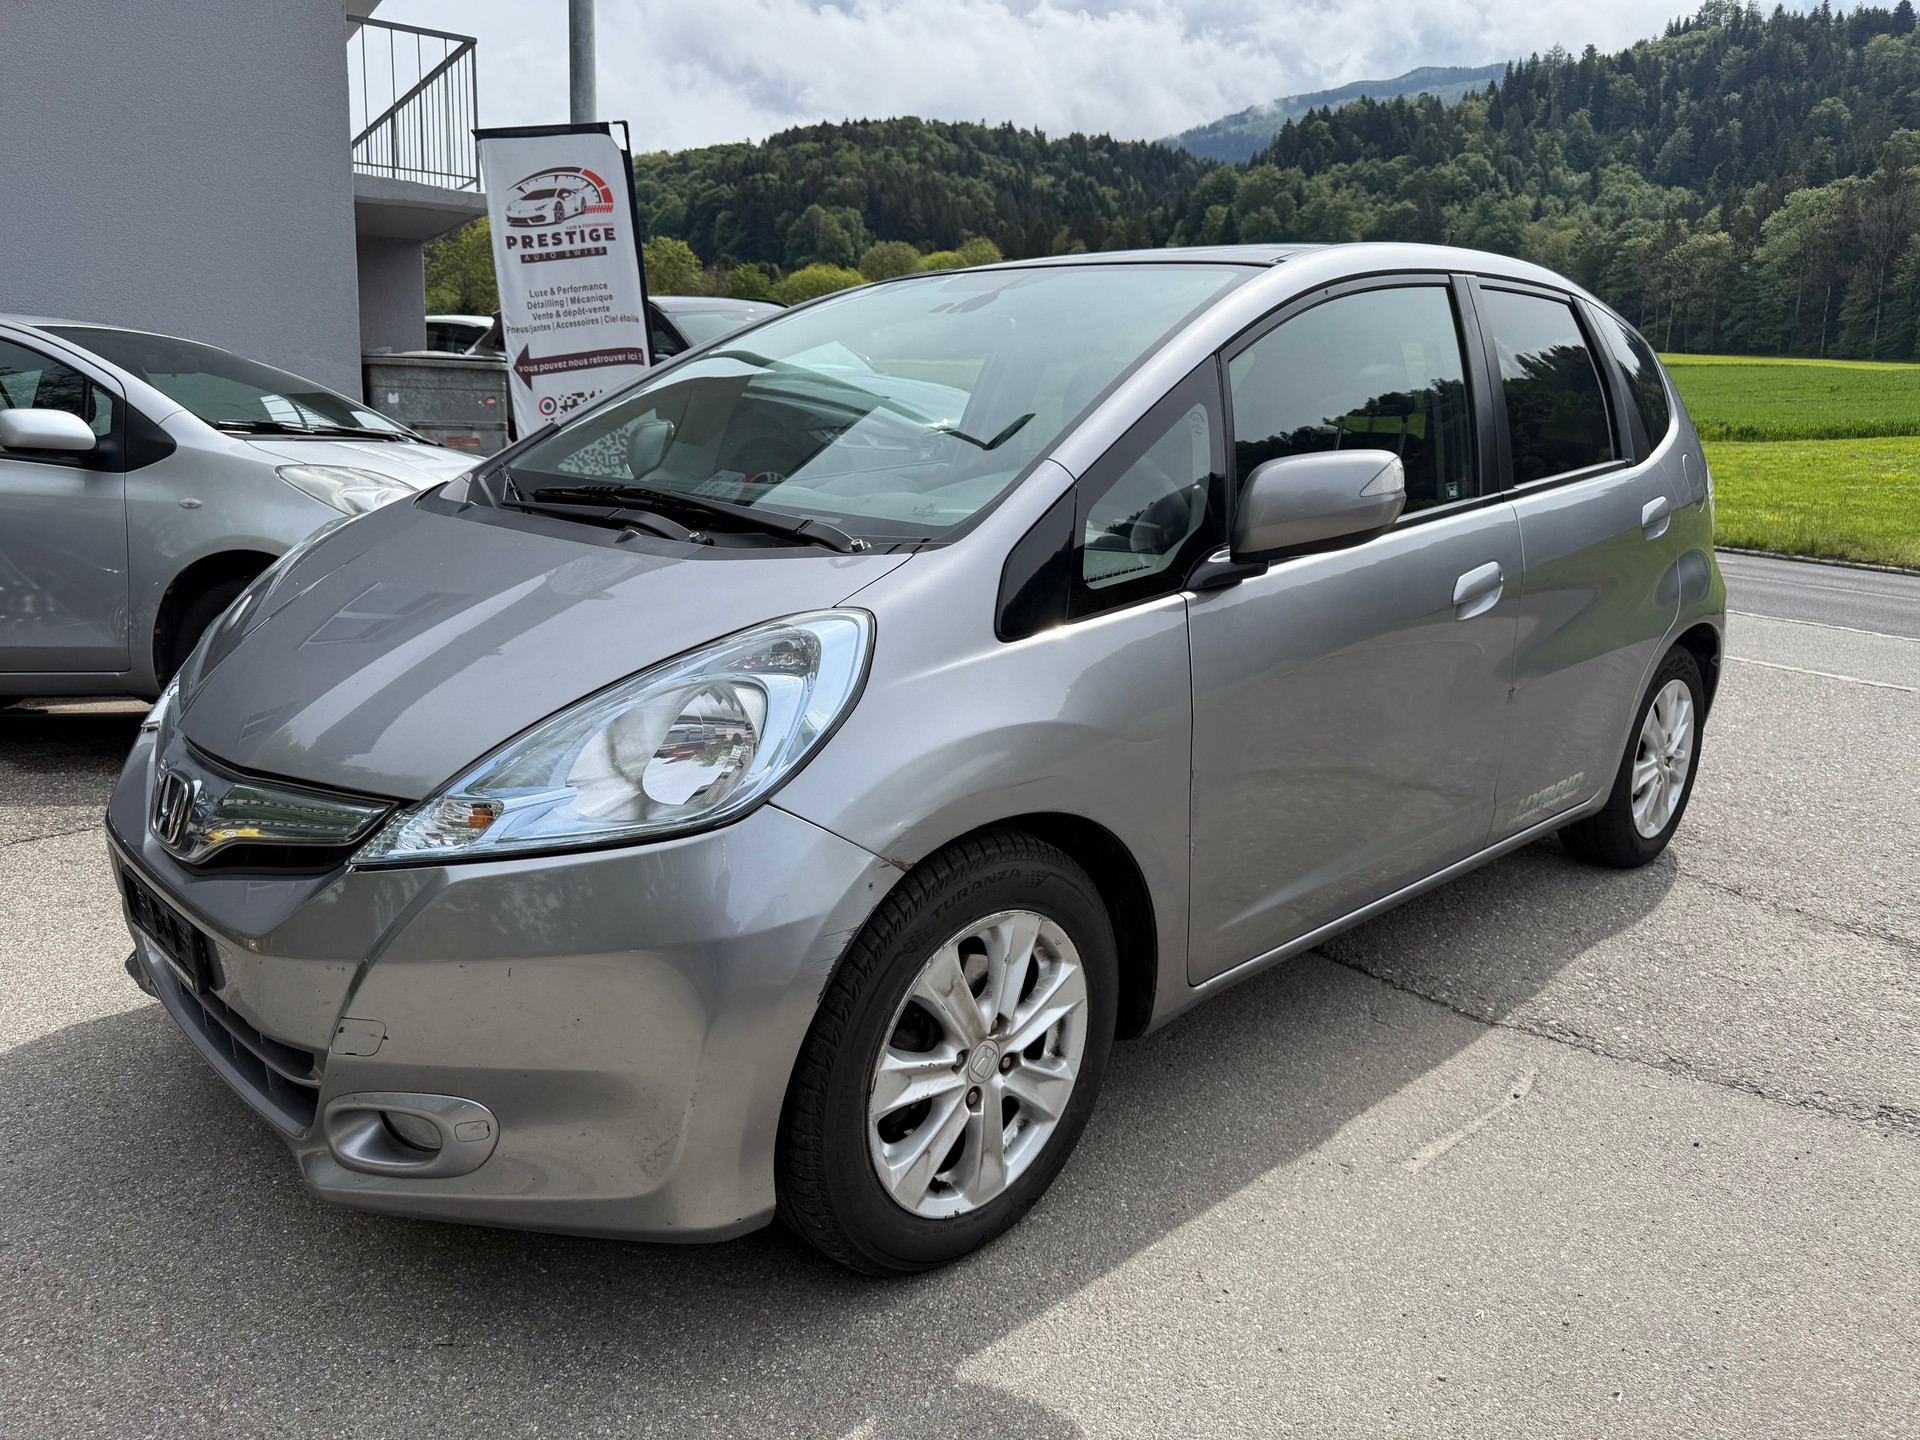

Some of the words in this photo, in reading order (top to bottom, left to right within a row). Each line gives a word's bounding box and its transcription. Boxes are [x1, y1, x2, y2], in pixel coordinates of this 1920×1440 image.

[506, 228, 616, 249] PRESTIGE
[524, 252, 557, 261] AUTO
[565, 247, 604, 257] SWISS
[529, 289, 548, 298] Luxe
[550, 287, 556, 296] &
[557, 283, 608, 295] Performance
[570, 294, 613, 304] Mécanique
[532, 312, 554, 320] Vente
[555, 310, 561, 318] &
[563, 305, 610, 318] dépôt-vente
[556, 318, 600, 329] Accessoires
[604, 315, 619, 324] Ciel
[519, 364, 538, 372] vous
[540, 361, 567, 373] pouvez
[568, 358, 588, 367] nous
[589, 353, 626, 364] retrouver
[627, 352, 638, 361] ici
[930, 868, 1021, 918] TURANZA
